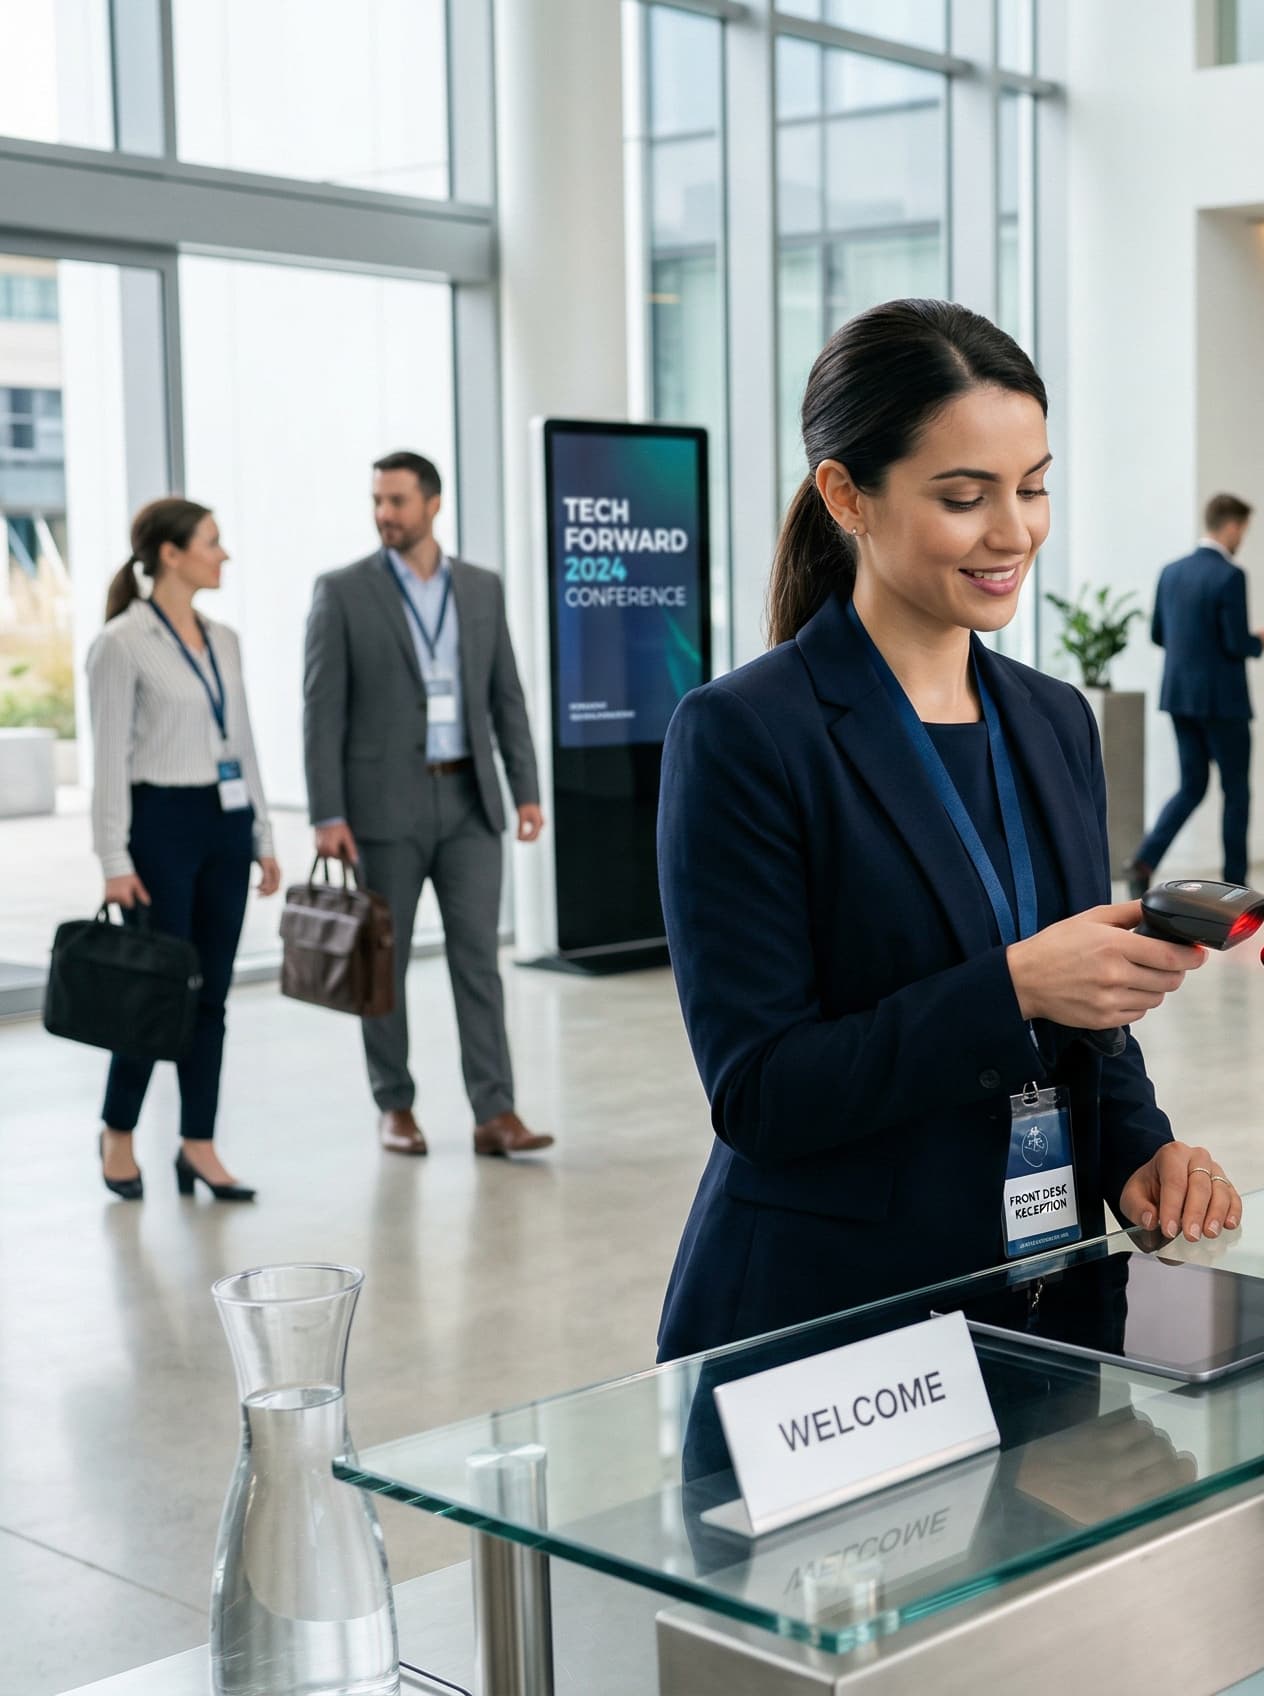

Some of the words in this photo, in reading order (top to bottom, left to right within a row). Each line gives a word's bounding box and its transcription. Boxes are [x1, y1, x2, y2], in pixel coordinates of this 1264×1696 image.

[563, 498, 629, 523] TECH
[564, 528, 688, 553] FORWARD
[564, 556, 627, 582] 2024
[565, 587, 686, 607] CONFERENCE
[1009, 1189, 1041, 1206] FRONT
[1043, 1183, 1067, 1199] DESK
[778, 1370, 946, 1452] WELCOME
